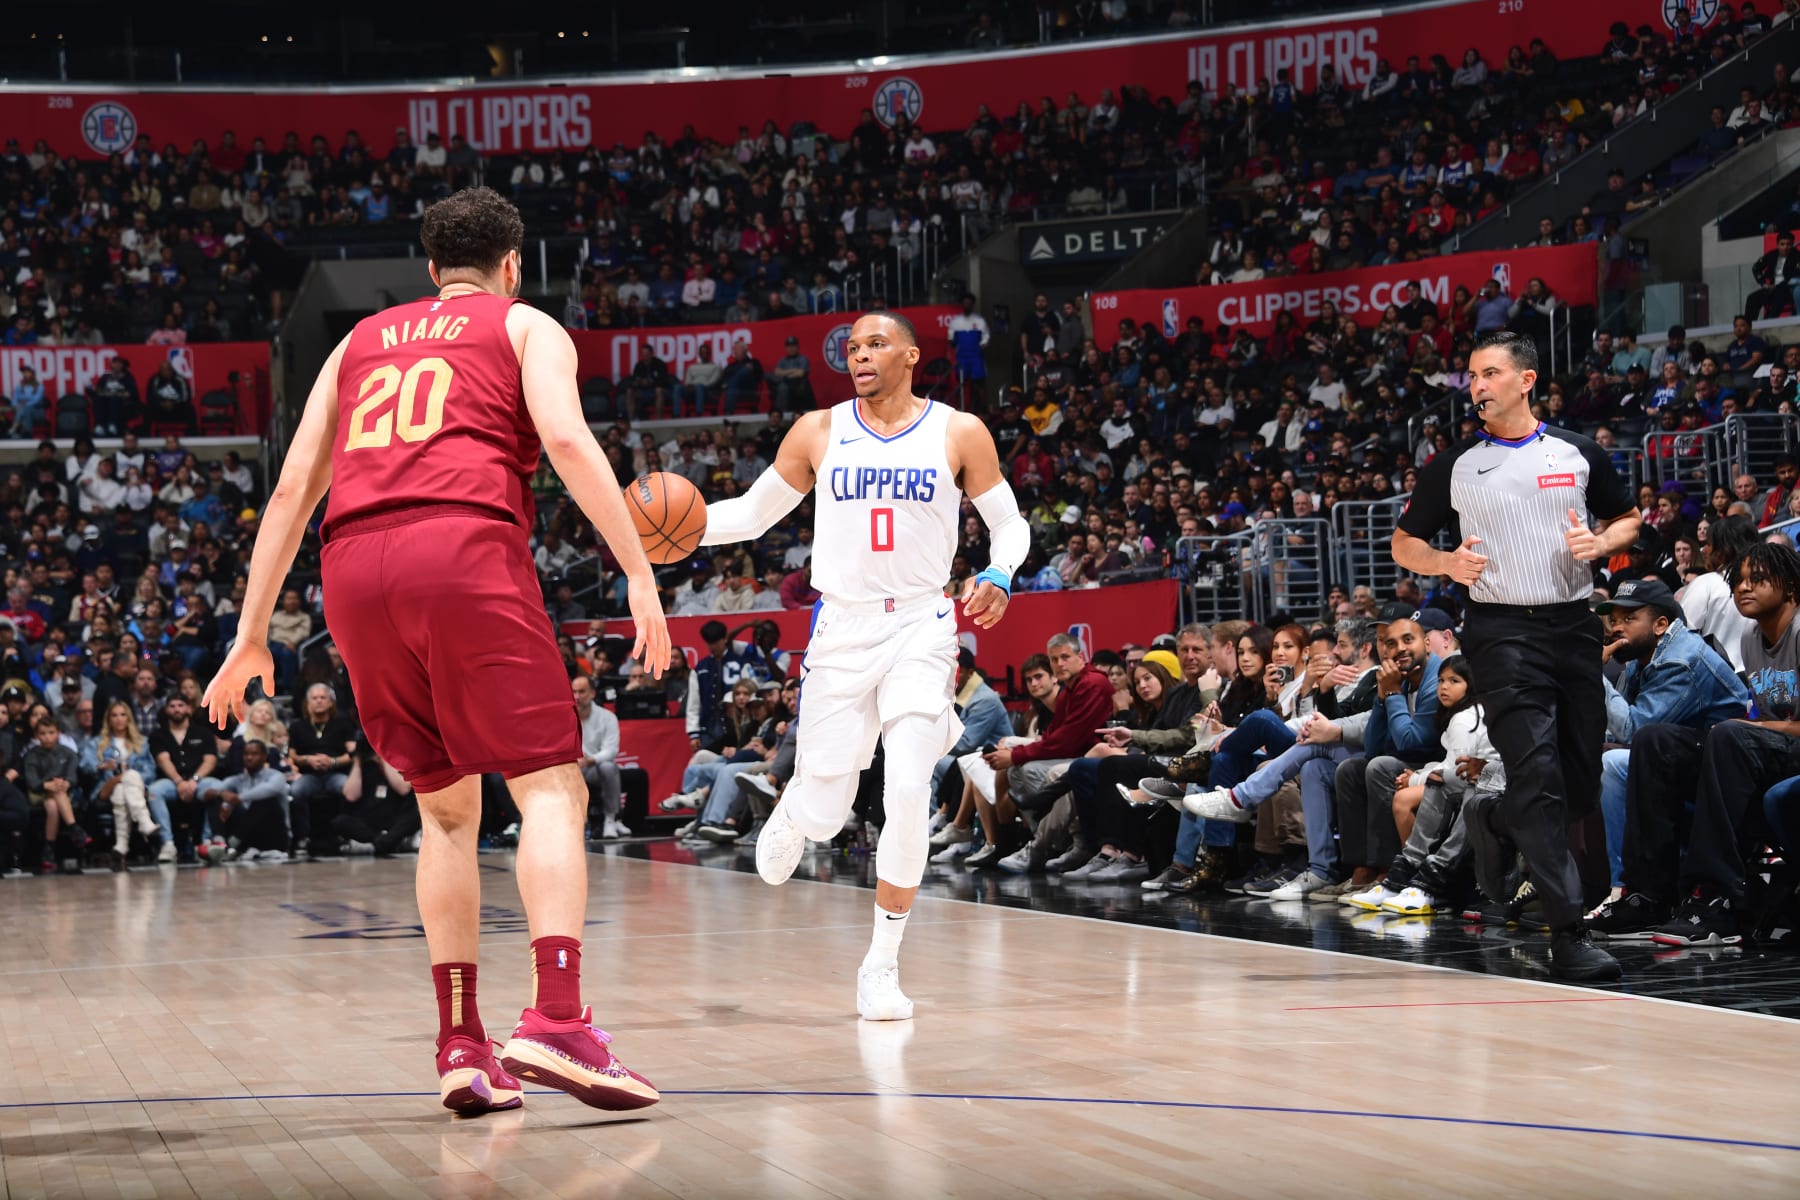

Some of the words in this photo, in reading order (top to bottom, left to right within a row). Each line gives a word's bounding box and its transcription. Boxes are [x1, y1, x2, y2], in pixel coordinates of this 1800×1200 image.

[1227, 27, 1377, 97] CLIPPERS
[447, 94, 592, 150] CLIPPERS
[1095, 296, 1118, 310] 108
[1217, 275, 1450, 327] CLIPPERS.COM
[381, 315, 470, 350] NIANG
[343, 357, 454, 453] 20
[831, 467, 937, 503] CLIPPERS
[1541, 474, 1573, 486] Emirates
[870, 507, 894, 552] 0
